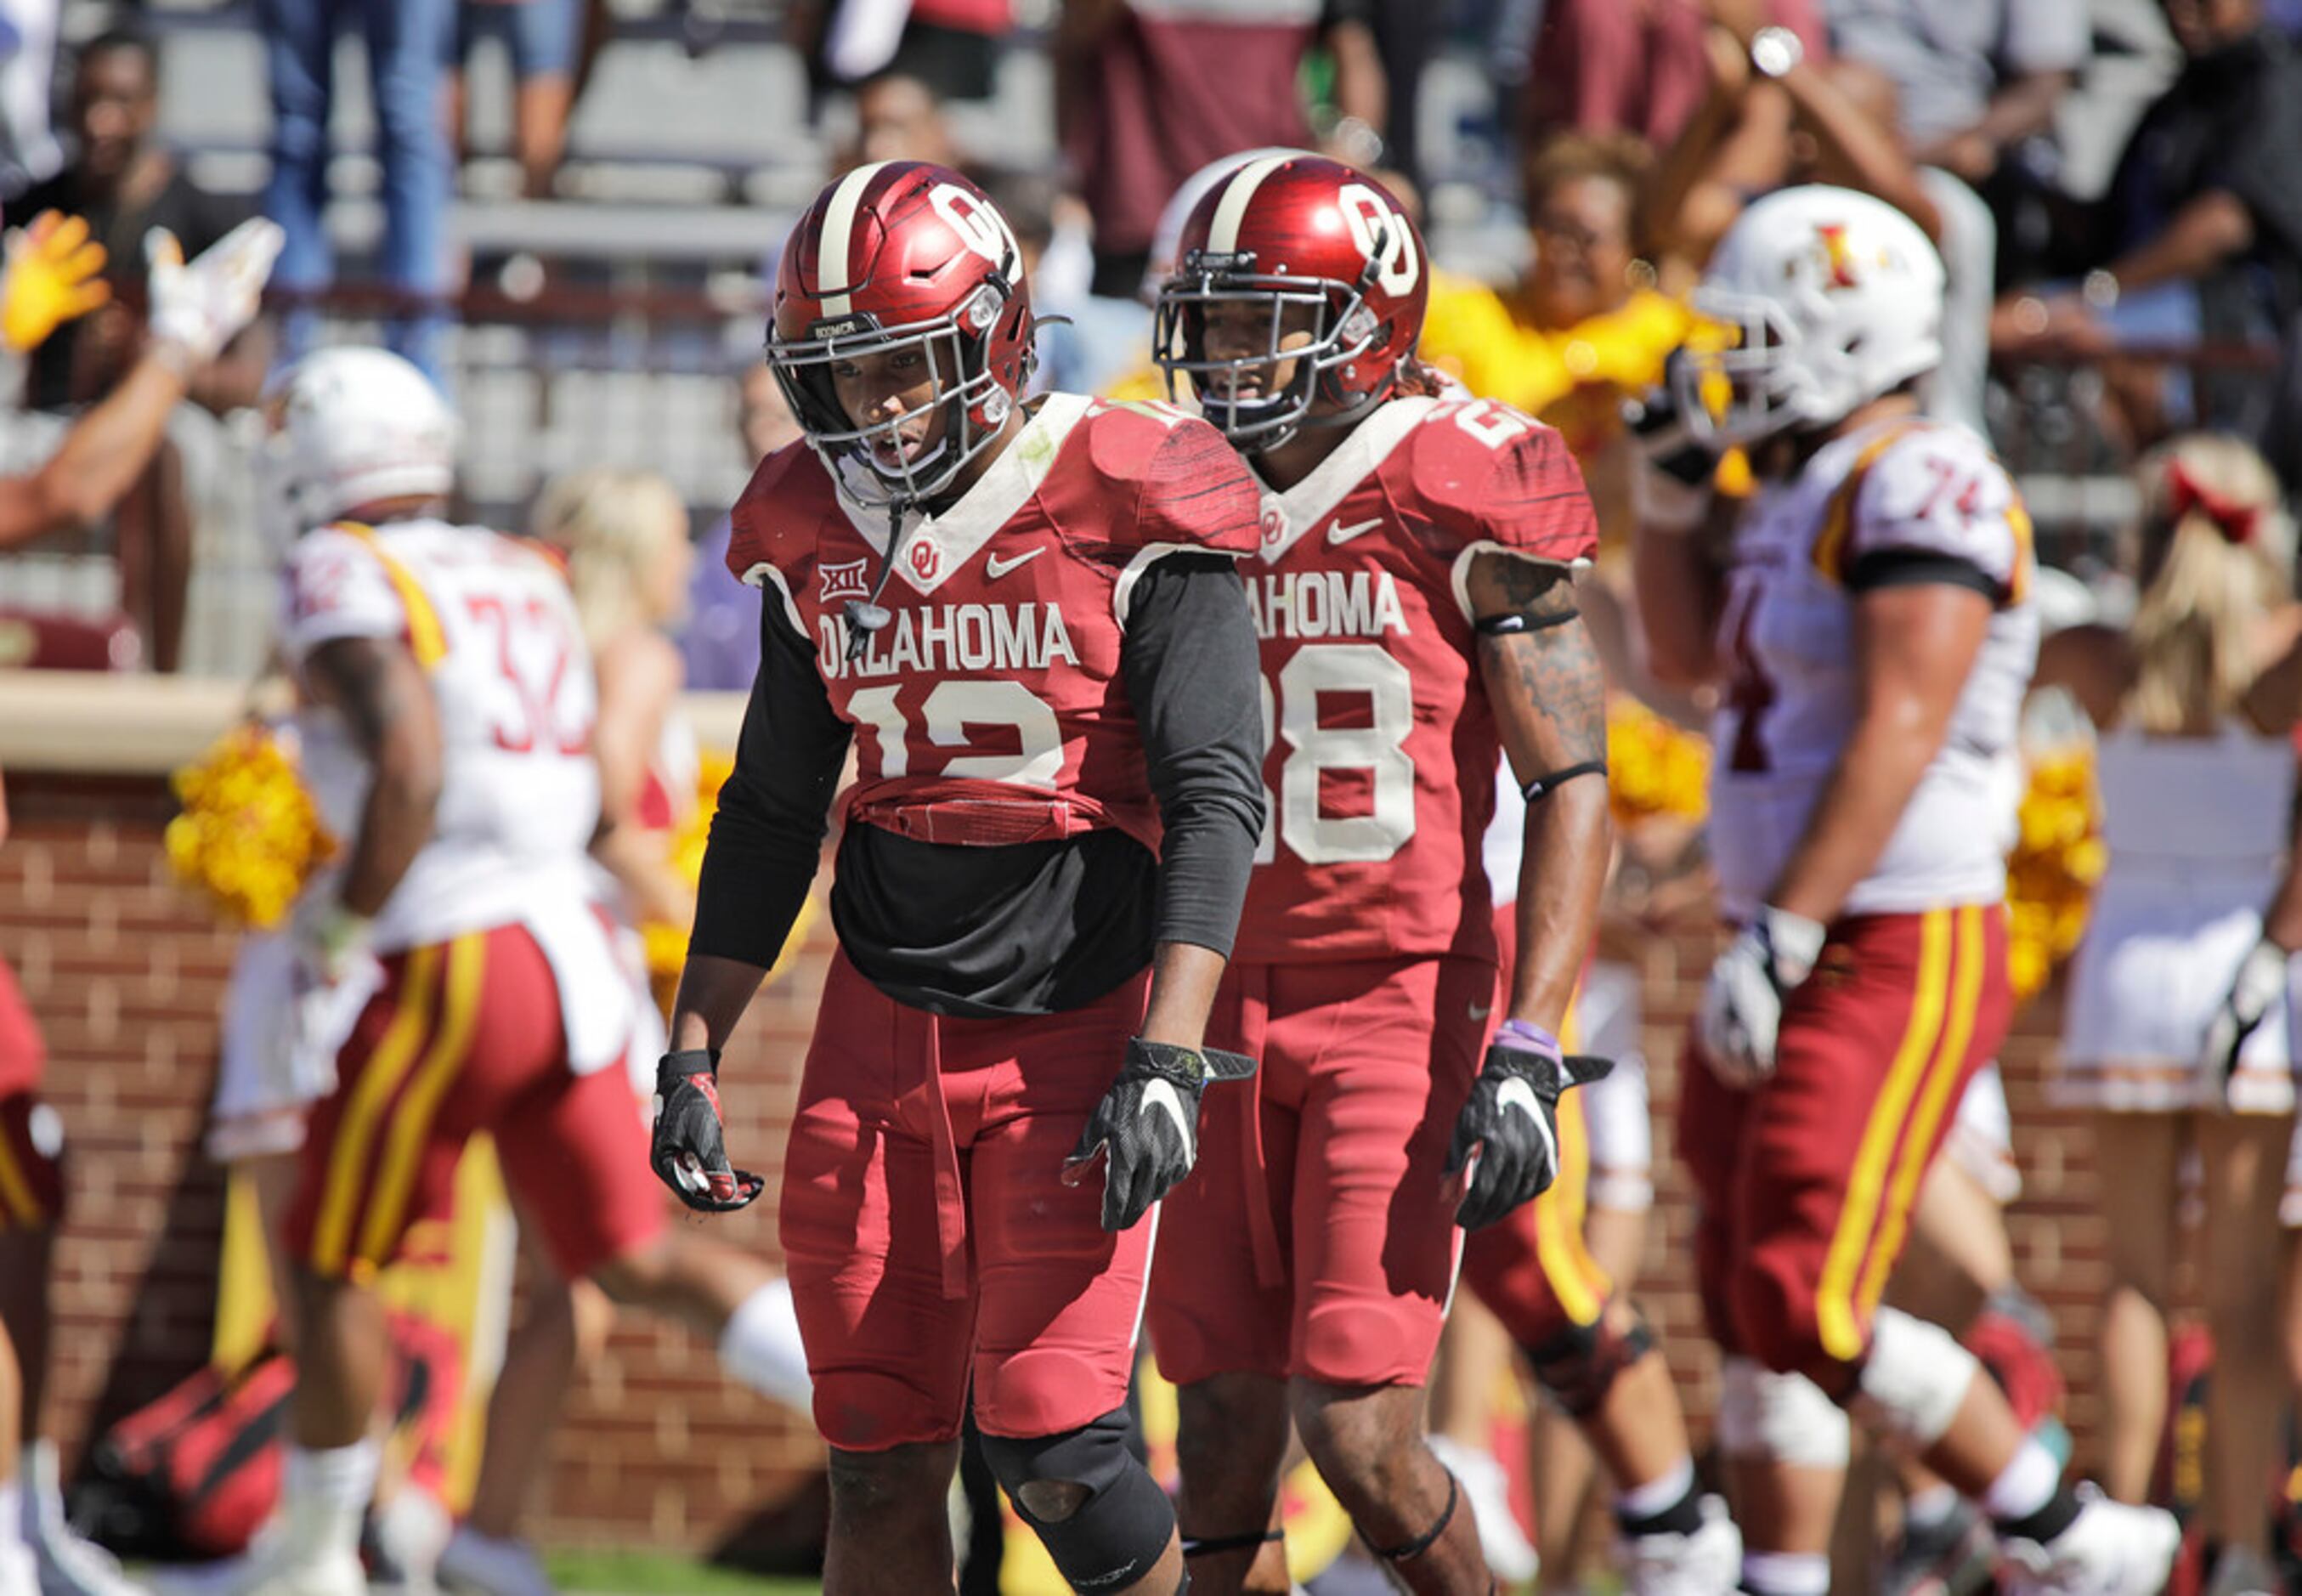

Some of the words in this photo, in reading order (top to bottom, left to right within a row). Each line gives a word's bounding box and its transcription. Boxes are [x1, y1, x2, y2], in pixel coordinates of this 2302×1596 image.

[1339, 184, 1419, 297] OU
[911, 540, 939, 580] OU
[1253, 643, 1417, 865] 8
